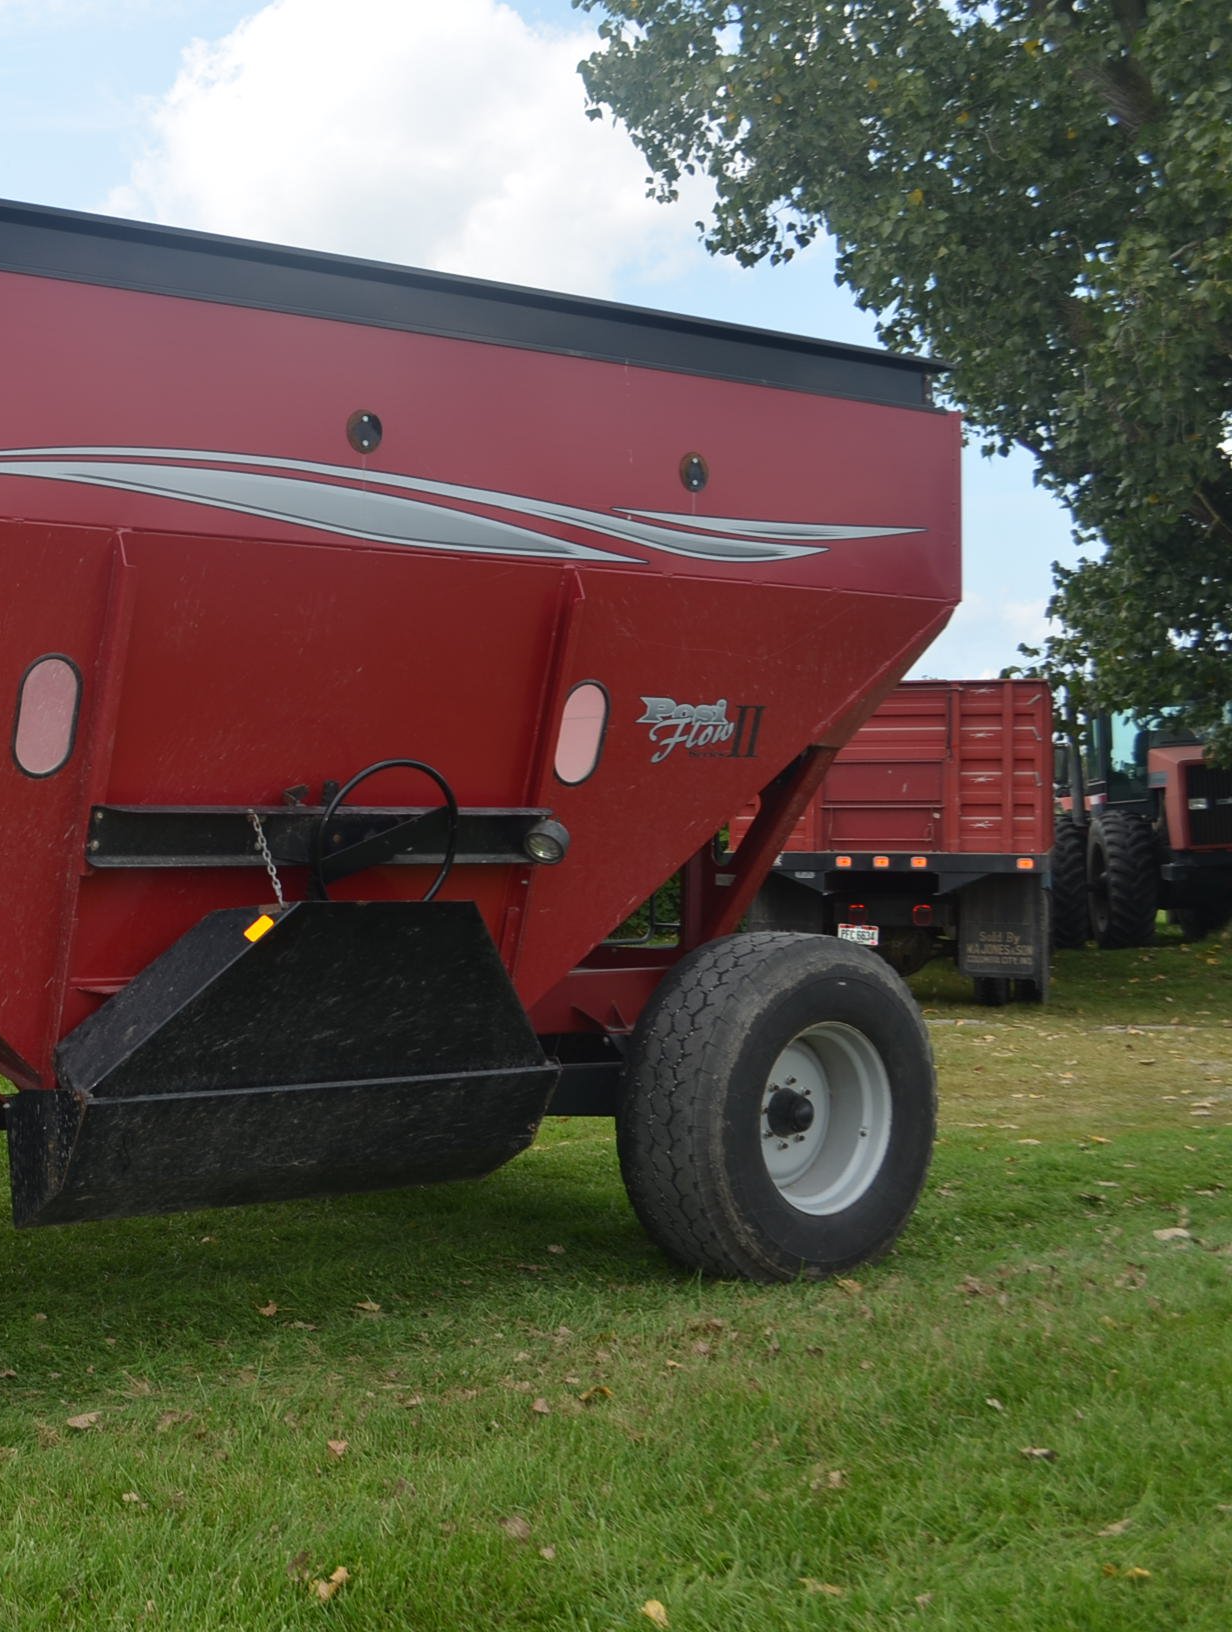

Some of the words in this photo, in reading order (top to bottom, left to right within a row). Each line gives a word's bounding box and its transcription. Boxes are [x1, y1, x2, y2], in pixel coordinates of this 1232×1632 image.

[635, 696, 729, 725] Posi
[649, 718, 736, 763] Flow
[726, 705, 768, 758] II
[978, 931, 1002, 943] Sold
[1006, 931, 1021, 945] By
